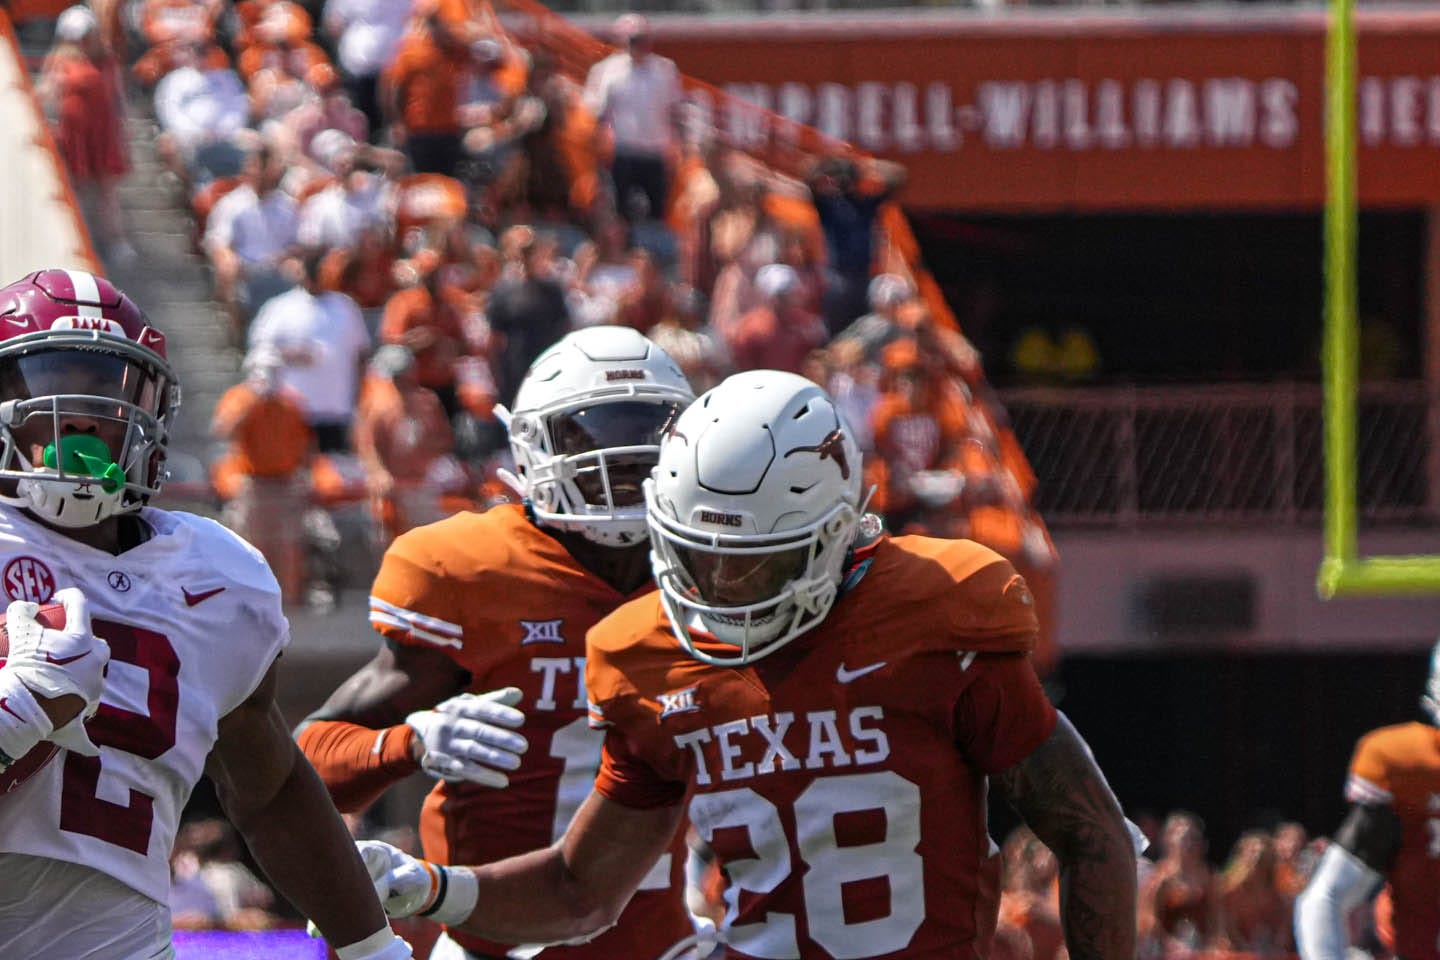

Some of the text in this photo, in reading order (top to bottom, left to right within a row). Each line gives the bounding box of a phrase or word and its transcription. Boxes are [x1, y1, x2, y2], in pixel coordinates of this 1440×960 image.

[71, 317, 112, 332] BAMA
[701, 510, 743, 527] HORNS
[7, 559, 52, 602] SEC
[60, 617, 181, 856] 2
[673, 705, 891, 786] TEXAS
[684, 770, 926, 960] 28
